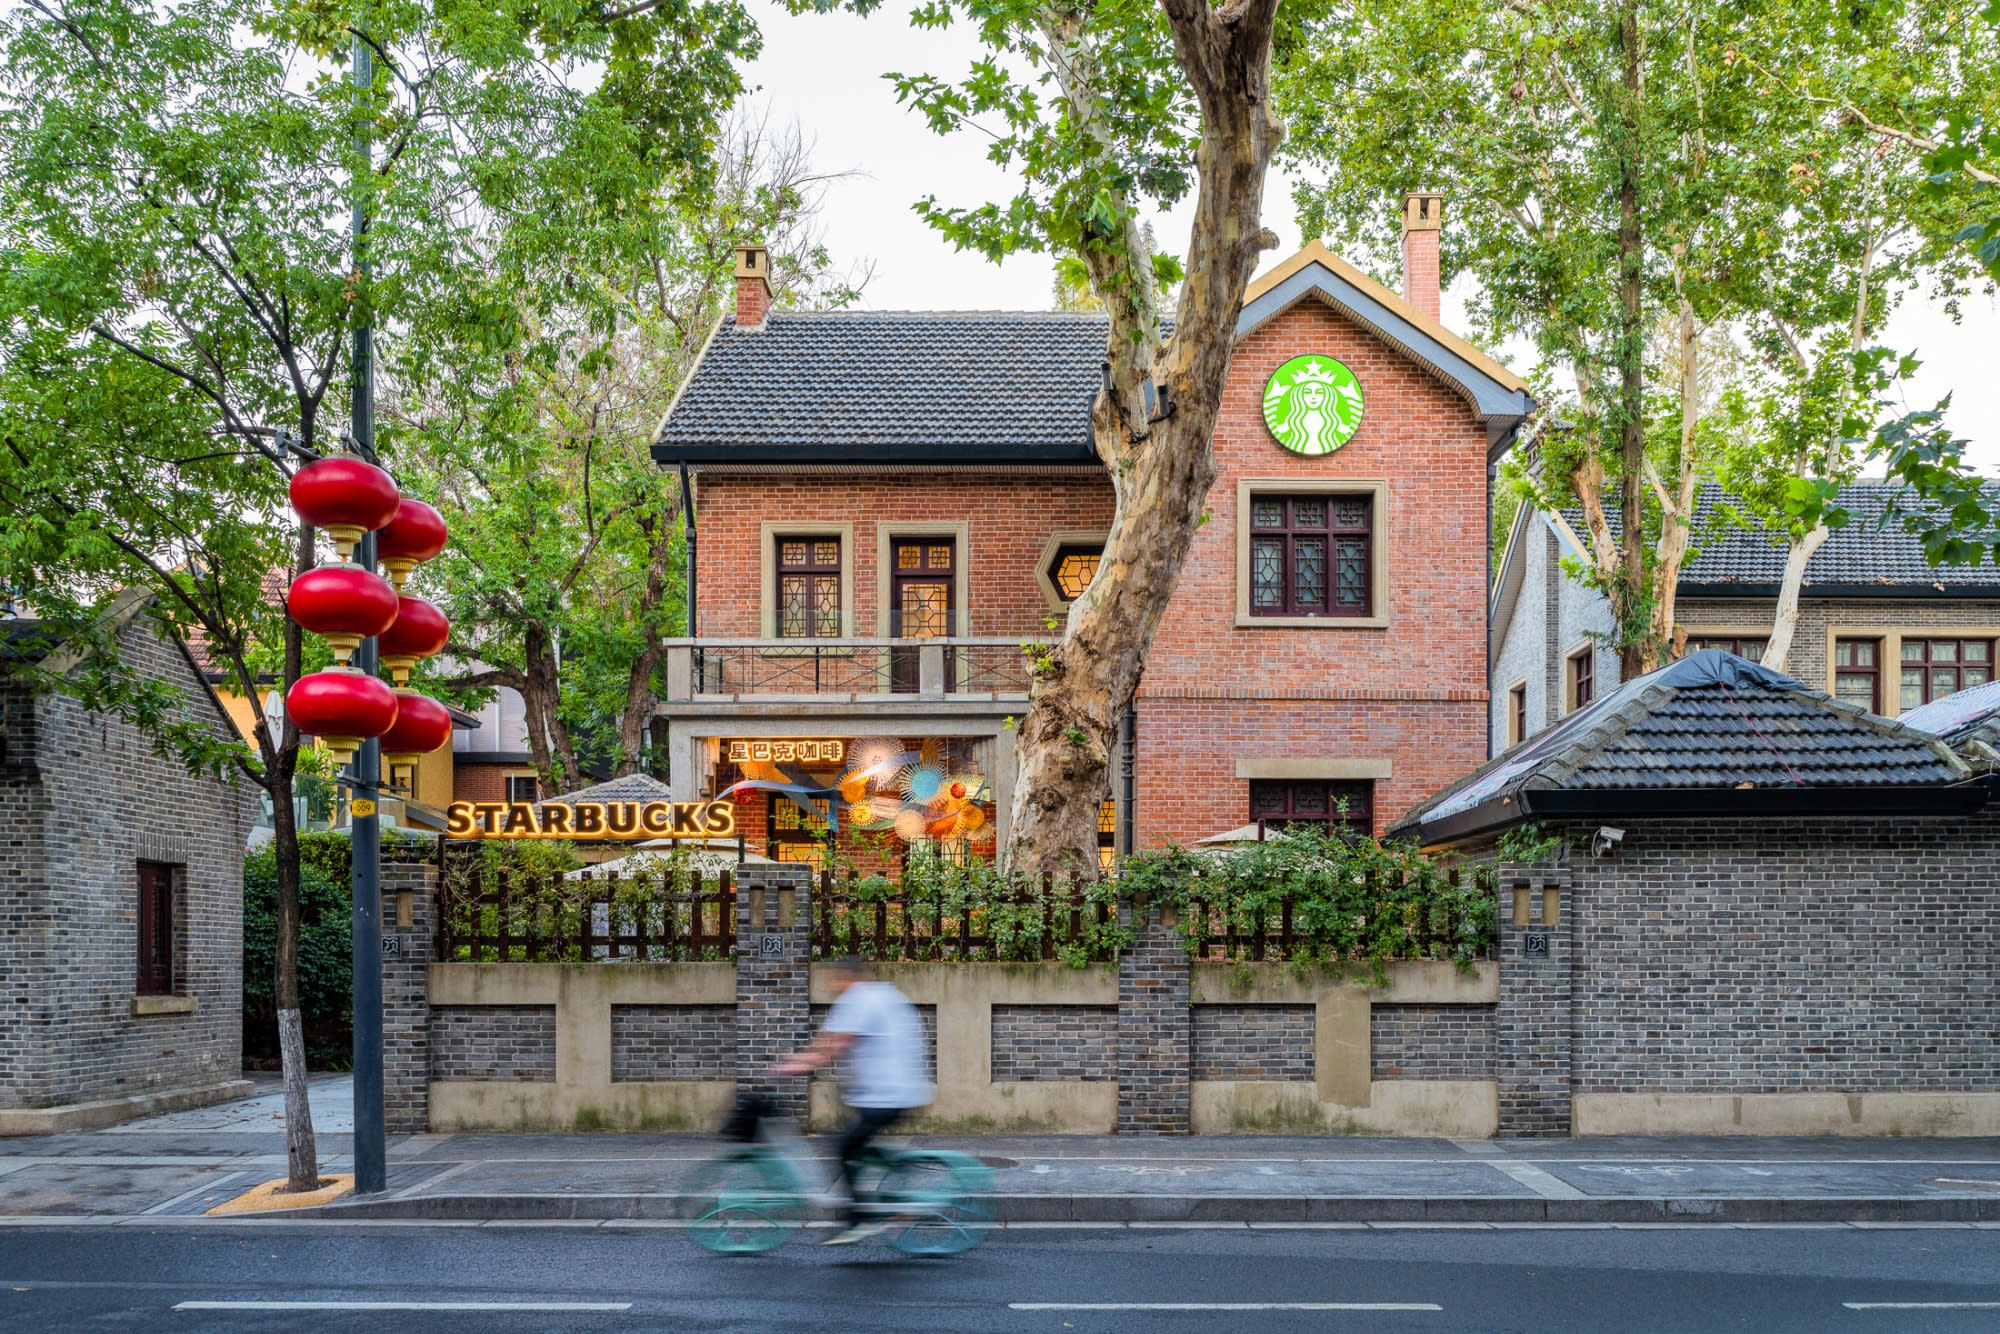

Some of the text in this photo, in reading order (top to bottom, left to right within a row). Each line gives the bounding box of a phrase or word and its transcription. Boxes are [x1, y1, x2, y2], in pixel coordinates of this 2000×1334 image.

[730, 740, 842, 761] 星巴克咖啡
[447, 801, 734, 836] STARBUCKS
